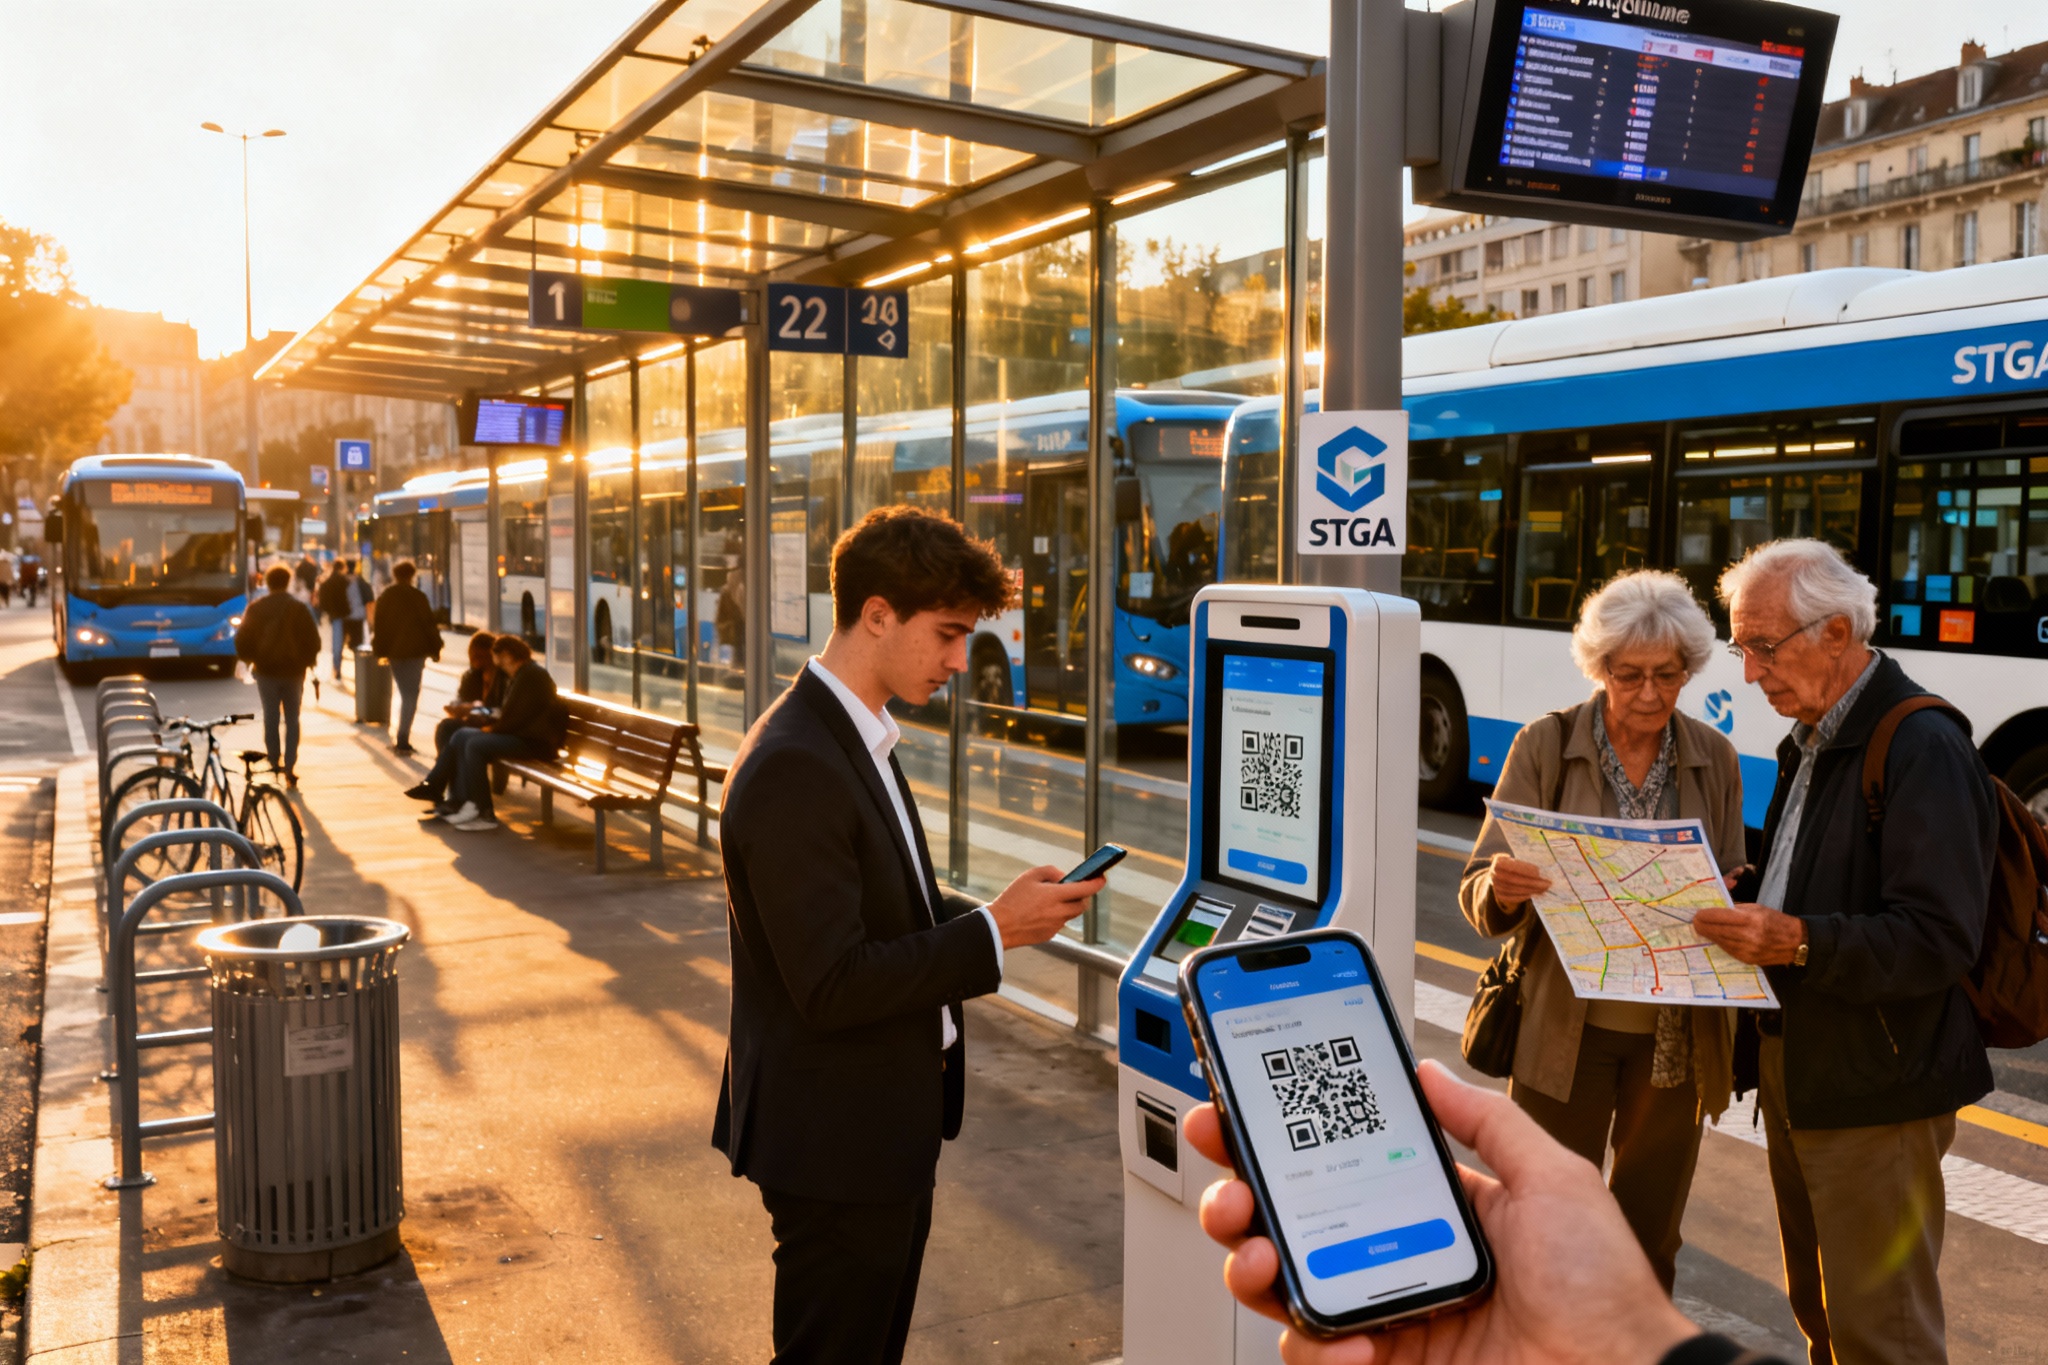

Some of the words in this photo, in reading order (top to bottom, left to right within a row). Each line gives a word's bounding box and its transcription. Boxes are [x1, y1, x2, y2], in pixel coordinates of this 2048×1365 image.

[548, 281, 565, 320] 1
[778, 295, 828, 339] 22
[1308, 517, 1396, 547] STGA
